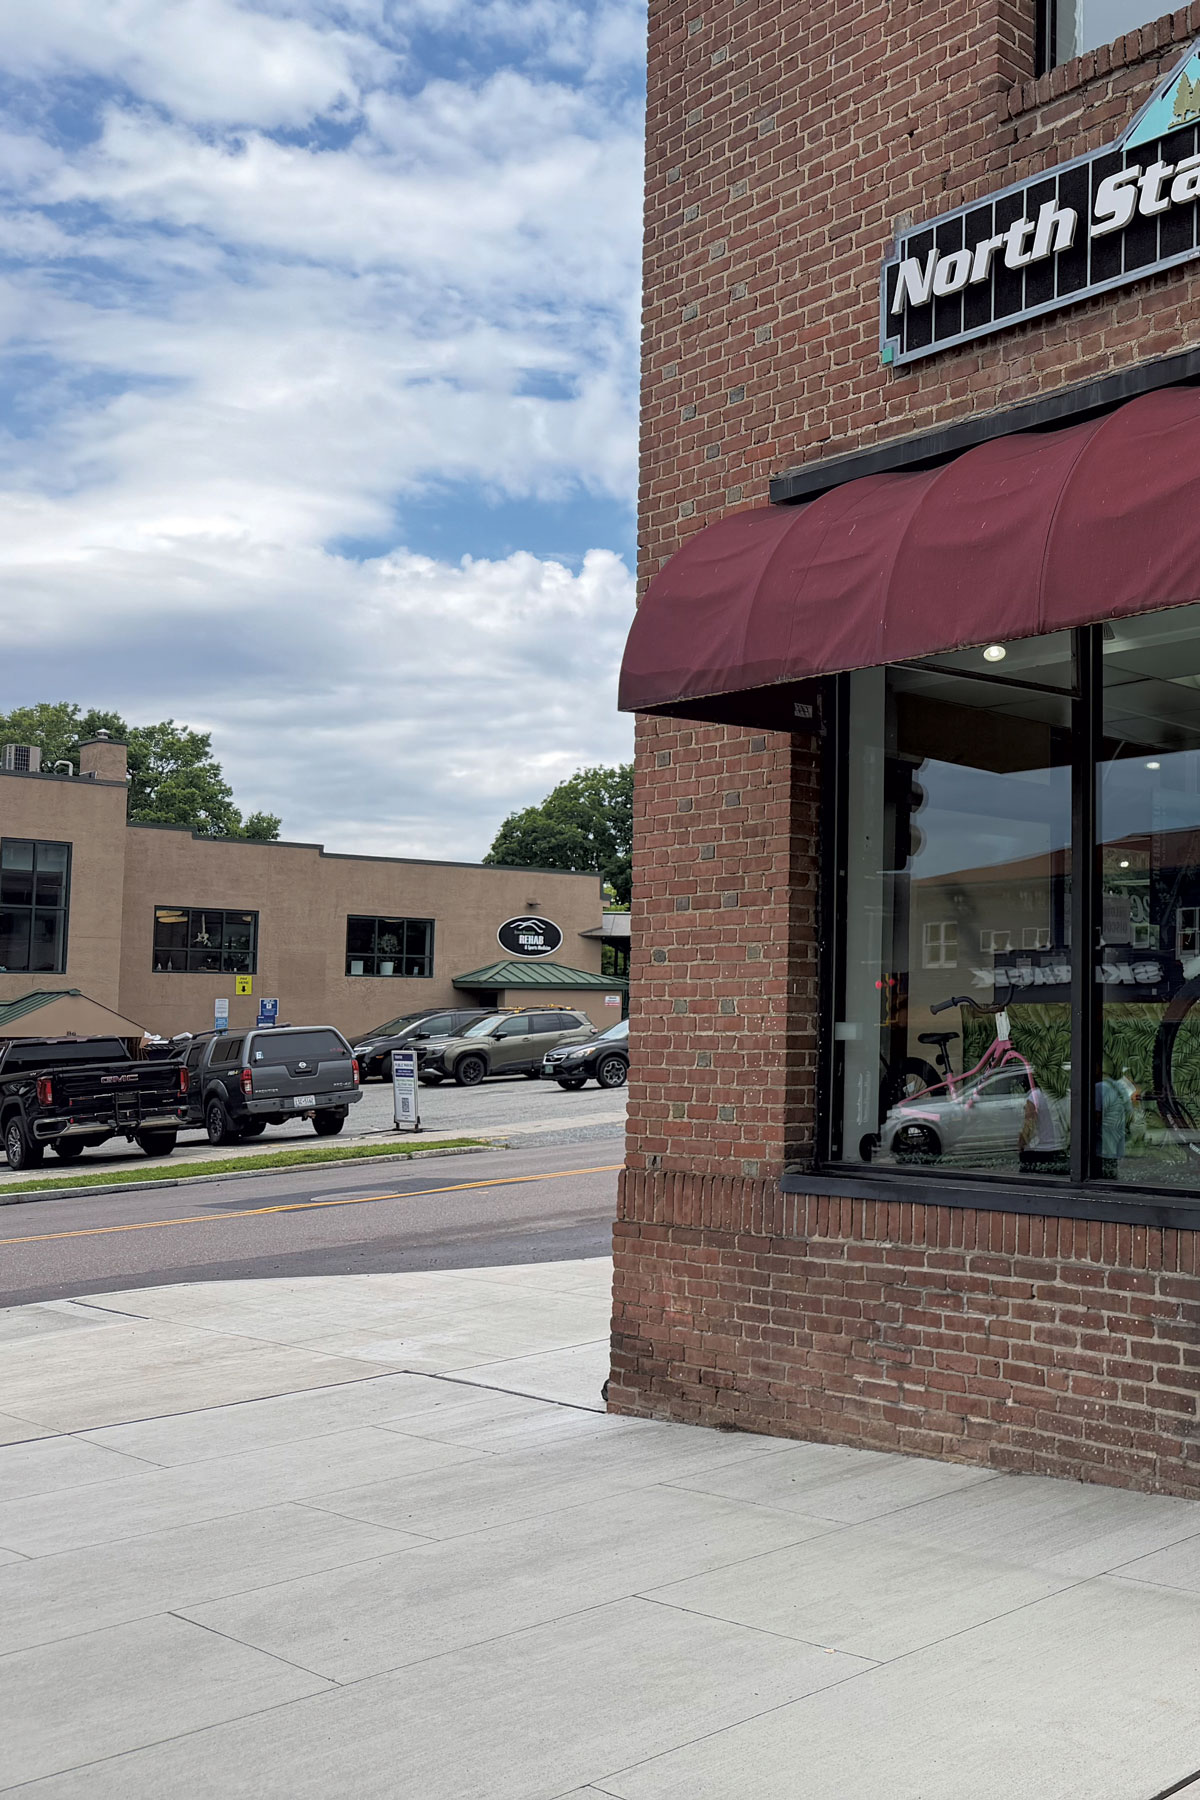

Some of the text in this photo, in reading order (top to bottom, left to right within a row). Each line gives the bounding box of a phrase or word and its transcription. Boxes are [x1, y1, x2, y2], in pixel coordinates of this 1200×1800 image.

[892, 200, 1077, 315] North
[519, 935, 544, 944] REHAB
[101, 1074, 139, 1083] GMC
